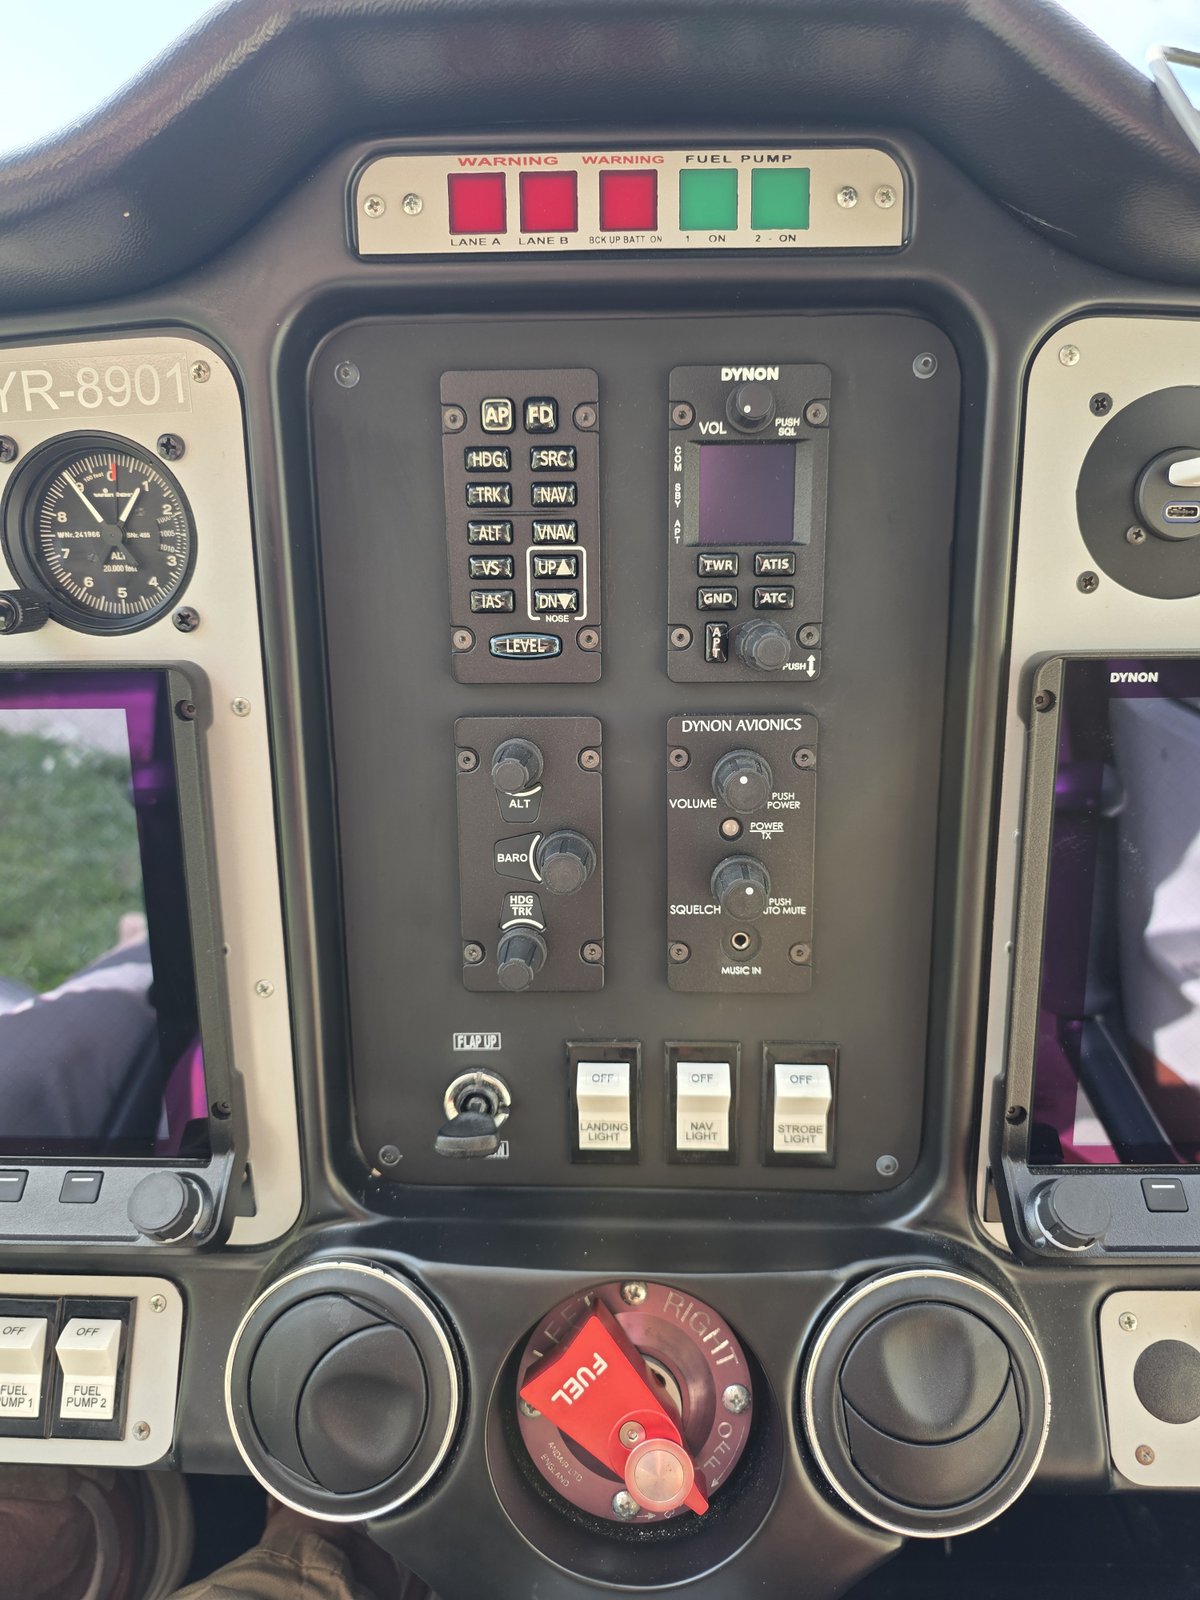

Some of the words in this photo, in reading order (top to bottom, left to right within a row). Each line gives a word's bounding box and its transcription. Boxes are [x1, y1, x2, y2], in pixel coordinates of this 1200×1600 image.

[457, 156, 559, 167] WARNING
[581, 155, 665, 165] WARNING
[685, 154, 732, 164] FUEL
[741, 154, 792, 163] PUMP
[450, 237, 487, 246] LANE
[491, 237, 501, 246] A
[518, 236, 555, 245] LANE
[560, 236, 569, 245] B
[589, 235, 607, 244] BCK
[609, 235, 621, 244] UP
[623, 235, 645, 244] BATT
[650, 235, 663, 243] ON
[779, 234, 797, 242] ON
[721, 367, 779, 381] DYNON
[485, 408, 509, 423] AP
[528, 408, 553, 424] FD
[699, 421, 727, 436] VOL
[775, 418, 800, 428] PUSH
[778, 427, 797, 436] SQL
[472, 451, 503, 467] HDG
[540, 451, 567, 467] SRC
[674, 446, 682, 472] COM
[143, 481, 149, 491] 1
[476, 487, 501, 502] TRK
[540, 486, 567, 502] NAV
[162, 504, 172, 515] 2
[57, 512, 67, 523] 8
[479, 525, 501, 541] ALT
[538, 524, 572, 541] VNAV
[61, 548, 70, 559] 7
[166, 555, 177, 567] 3
[704, 559, 733, 571] TWR
[761, 558, 789, 570] ATIS
[482, 560, 500, 575] VS
[539, 560, 557, 575] UP
[84, 576, 94, 587] 6
[149, 576, 159, 587] 4
[117, 587, 127, 598] 5
[482, 594, 502, 609] IAS
[540, 594, 558, 609] DN
[704, 593, 732, 604] GND
[763, 593, 787, 604] ATC
[545, 614, 570, 623] NOSE
[506, 639, 545, 653] LEVEL
[712, 627, 721, 659] APT
[1110, 672, 1159, 683] DYNON
[681, 719, 732, 733] DYNON
[736, 718, 802, 732] AVIONICS
[772, 792, 795, 800] PUSH
[509, 799, 531, 809] ALT
[669, 798, 717, 809] VOLUME
[767, 801, 800, 810] POWER
[750, 822, 784, 830] POWER
[761, 832, 772, 840] TX
[497, 854, 528, 863] BARO
[510, 895, 534, 905] HDG
[769, 898, 792, 906] PUSH
[512, 906, 533, 916] TRK
[670, 904, 721, 915] SQUELCH
[763, 906, 781, 915] UTO
[782, 906, 807, 915] MUTE
[721, 966, 750, 975] MUSIC
[752, 966, 762, 975] IN
[457, 1035, 482, 1048] FLAP
[484, 1035, 497, 1048] UP
[591, 1074, 614, 1083] OFF
[691, 1073, 713, 1083] OFF
[790, 1075, 813, 1084] OFF
[580, 1122, 629, 1131] LANDING
[690, 1122, 713, 1131] NAV
[778, 1125, 823, 1134] STROBE
[588, 1132, 620, 1141] LIGHT
[685, 1132, 718, 1141] LIGHT
[783, 1135, 817, 1144] LIGHT
[2, 1326, 27, 1335] OFF
[76, 1327, 100, 1336] OFF
[663, 1290, 739, 1366] RIGHT
[551, 1352, 609, 1405] FUEL
[0, 1385, 27, 1395] FUEL
[73, 1385, 101, 1396] FUEL
[0, 1396, 25, 1408] UMP
[28, 1398, 33, 1408] 1
[66, 1397, 97, 1408] PUMP
[100, 1398, 107, 1408] 2
[703, 1421, 733, 1468] OFF
